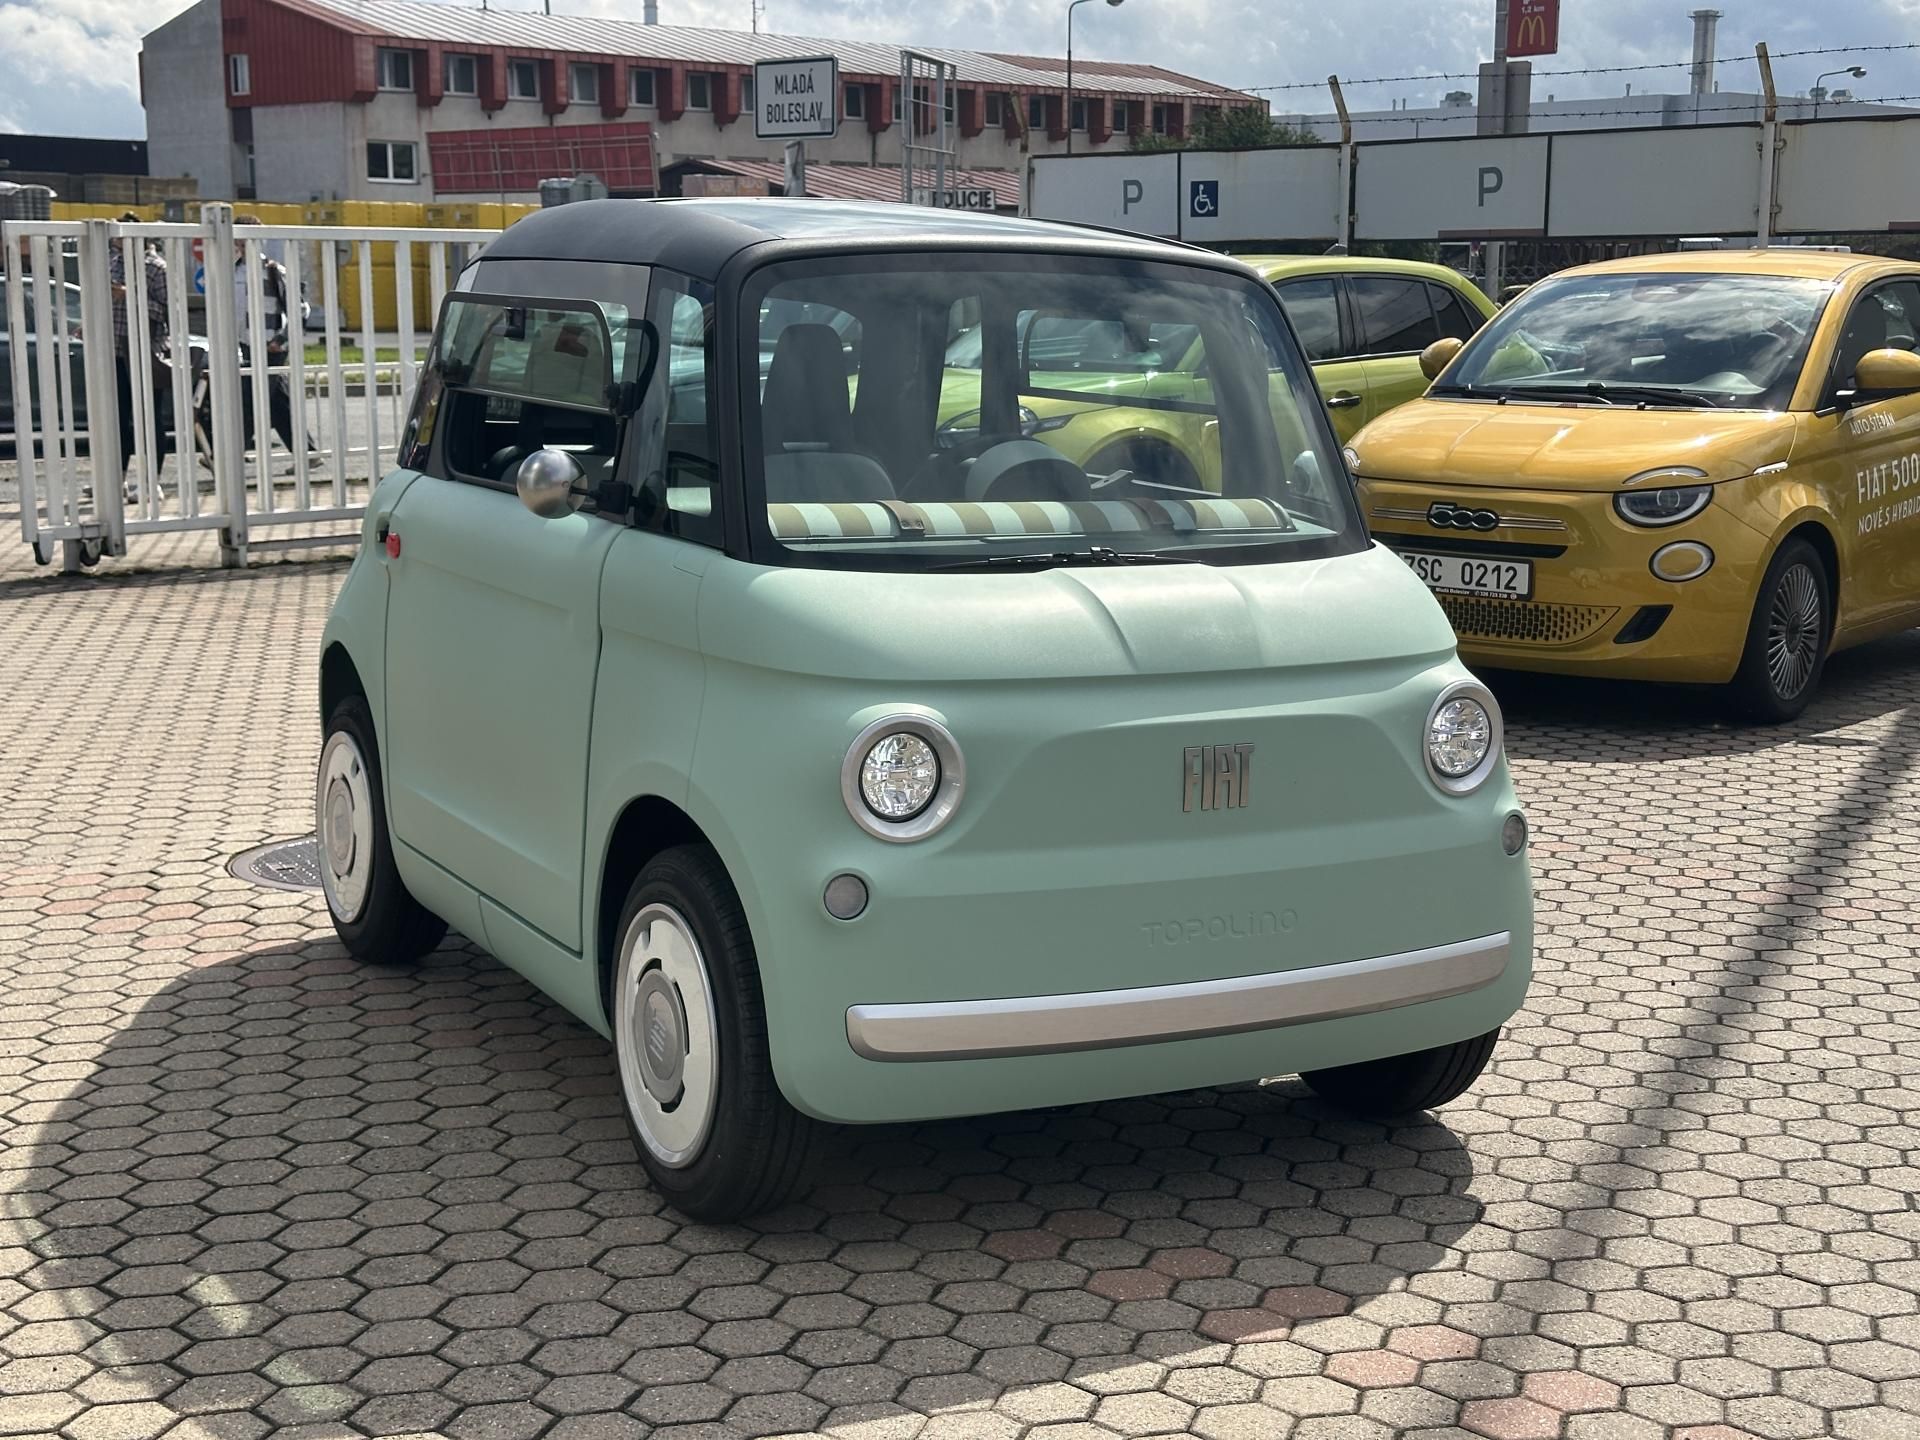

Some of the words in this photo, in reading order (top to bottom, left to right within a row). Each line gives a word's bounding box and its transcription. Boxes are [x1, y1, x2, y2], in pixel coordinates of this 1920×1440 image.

[774, 67, 815, 95] MLADÁ
[766, 101, 823, 124] BOLESLAV
[1122, 179, 1143, 215] P
[1478, 166, 1503, 207] P
[1849, 418, 1871, 435] AUTO
[1857, 463, 1887, 504] FIAT
[1891, 452, 1919, 492] 500
[1884, 506, 1890, 526] S
[1460, 561, 1518, 591] 0212
[1183, 743, 1255, 812] FIAT
